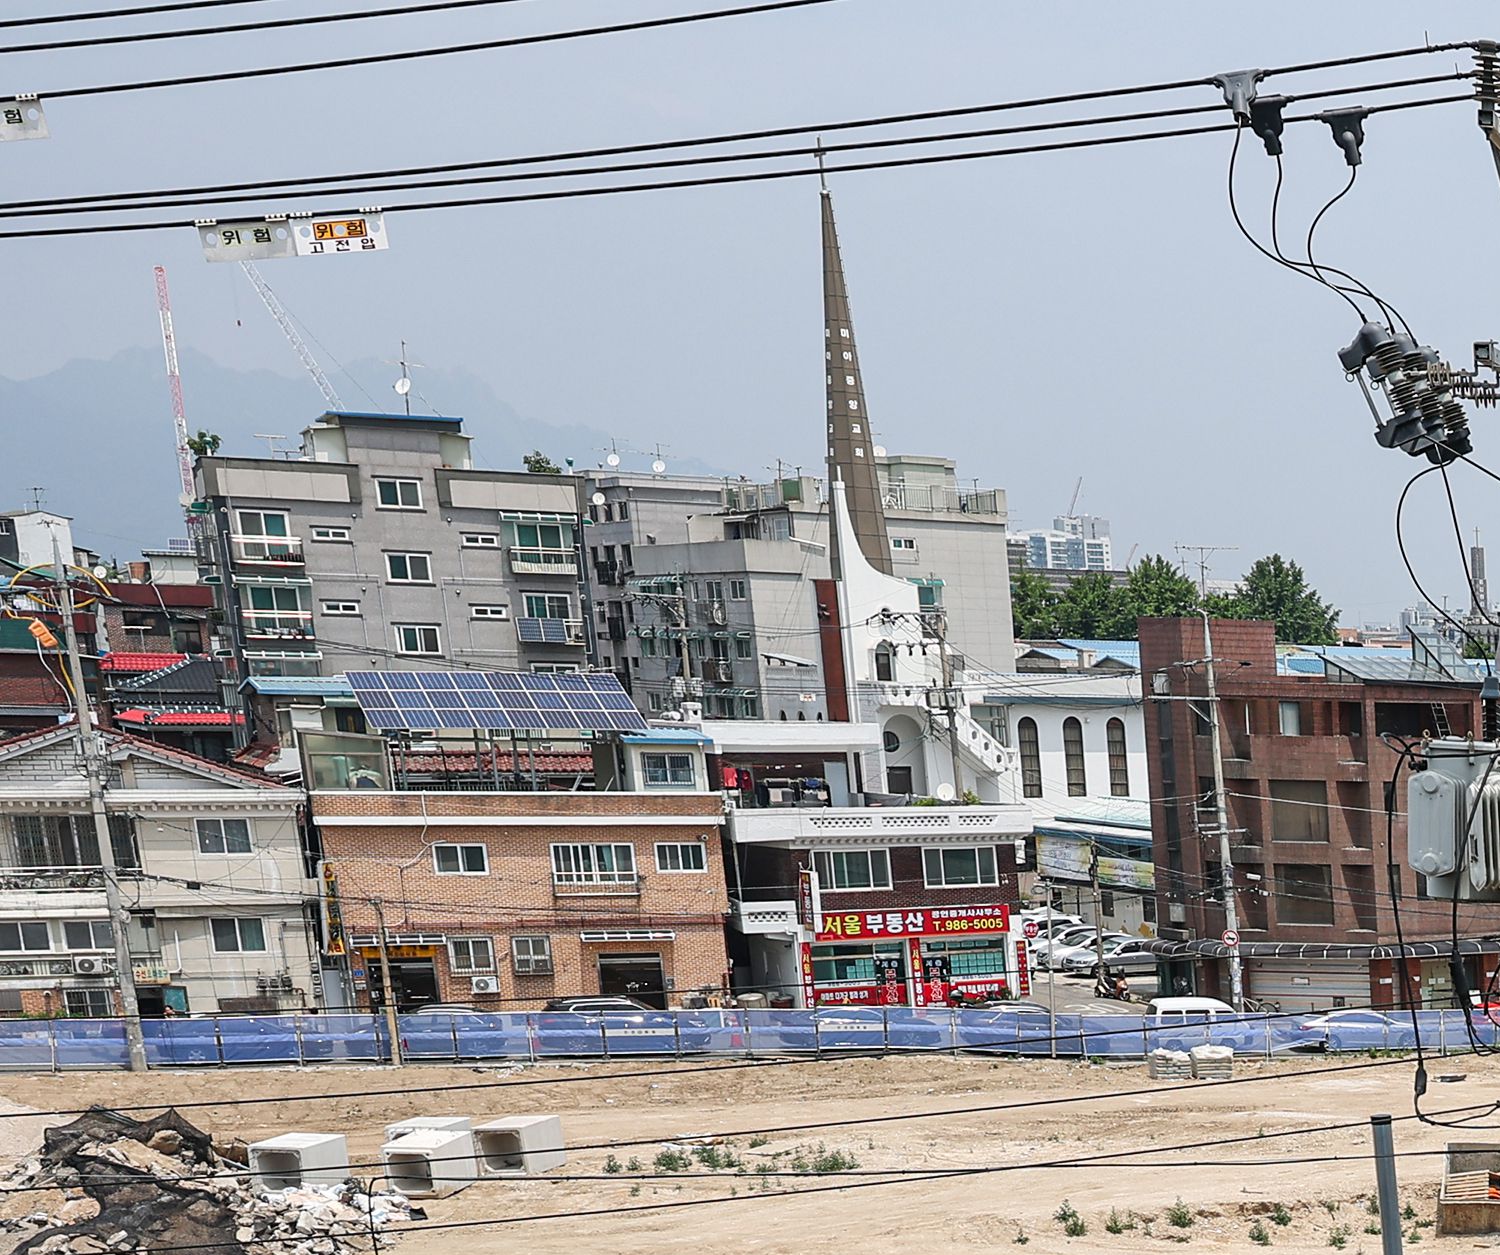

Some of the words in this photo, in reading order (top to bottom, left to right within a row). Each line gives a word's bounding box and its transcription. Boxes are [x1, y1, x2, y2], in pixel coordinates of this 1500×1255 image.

[222, 228, 272, 245] 위험
[316, 221, 364, 238] 위험
[309, 238, 376, 254] 고전압
[824, 915, 862, 936] 서울
[865, 912, 924, 935] 부동산
[933, 918, 1004, 932] T.986-5005
